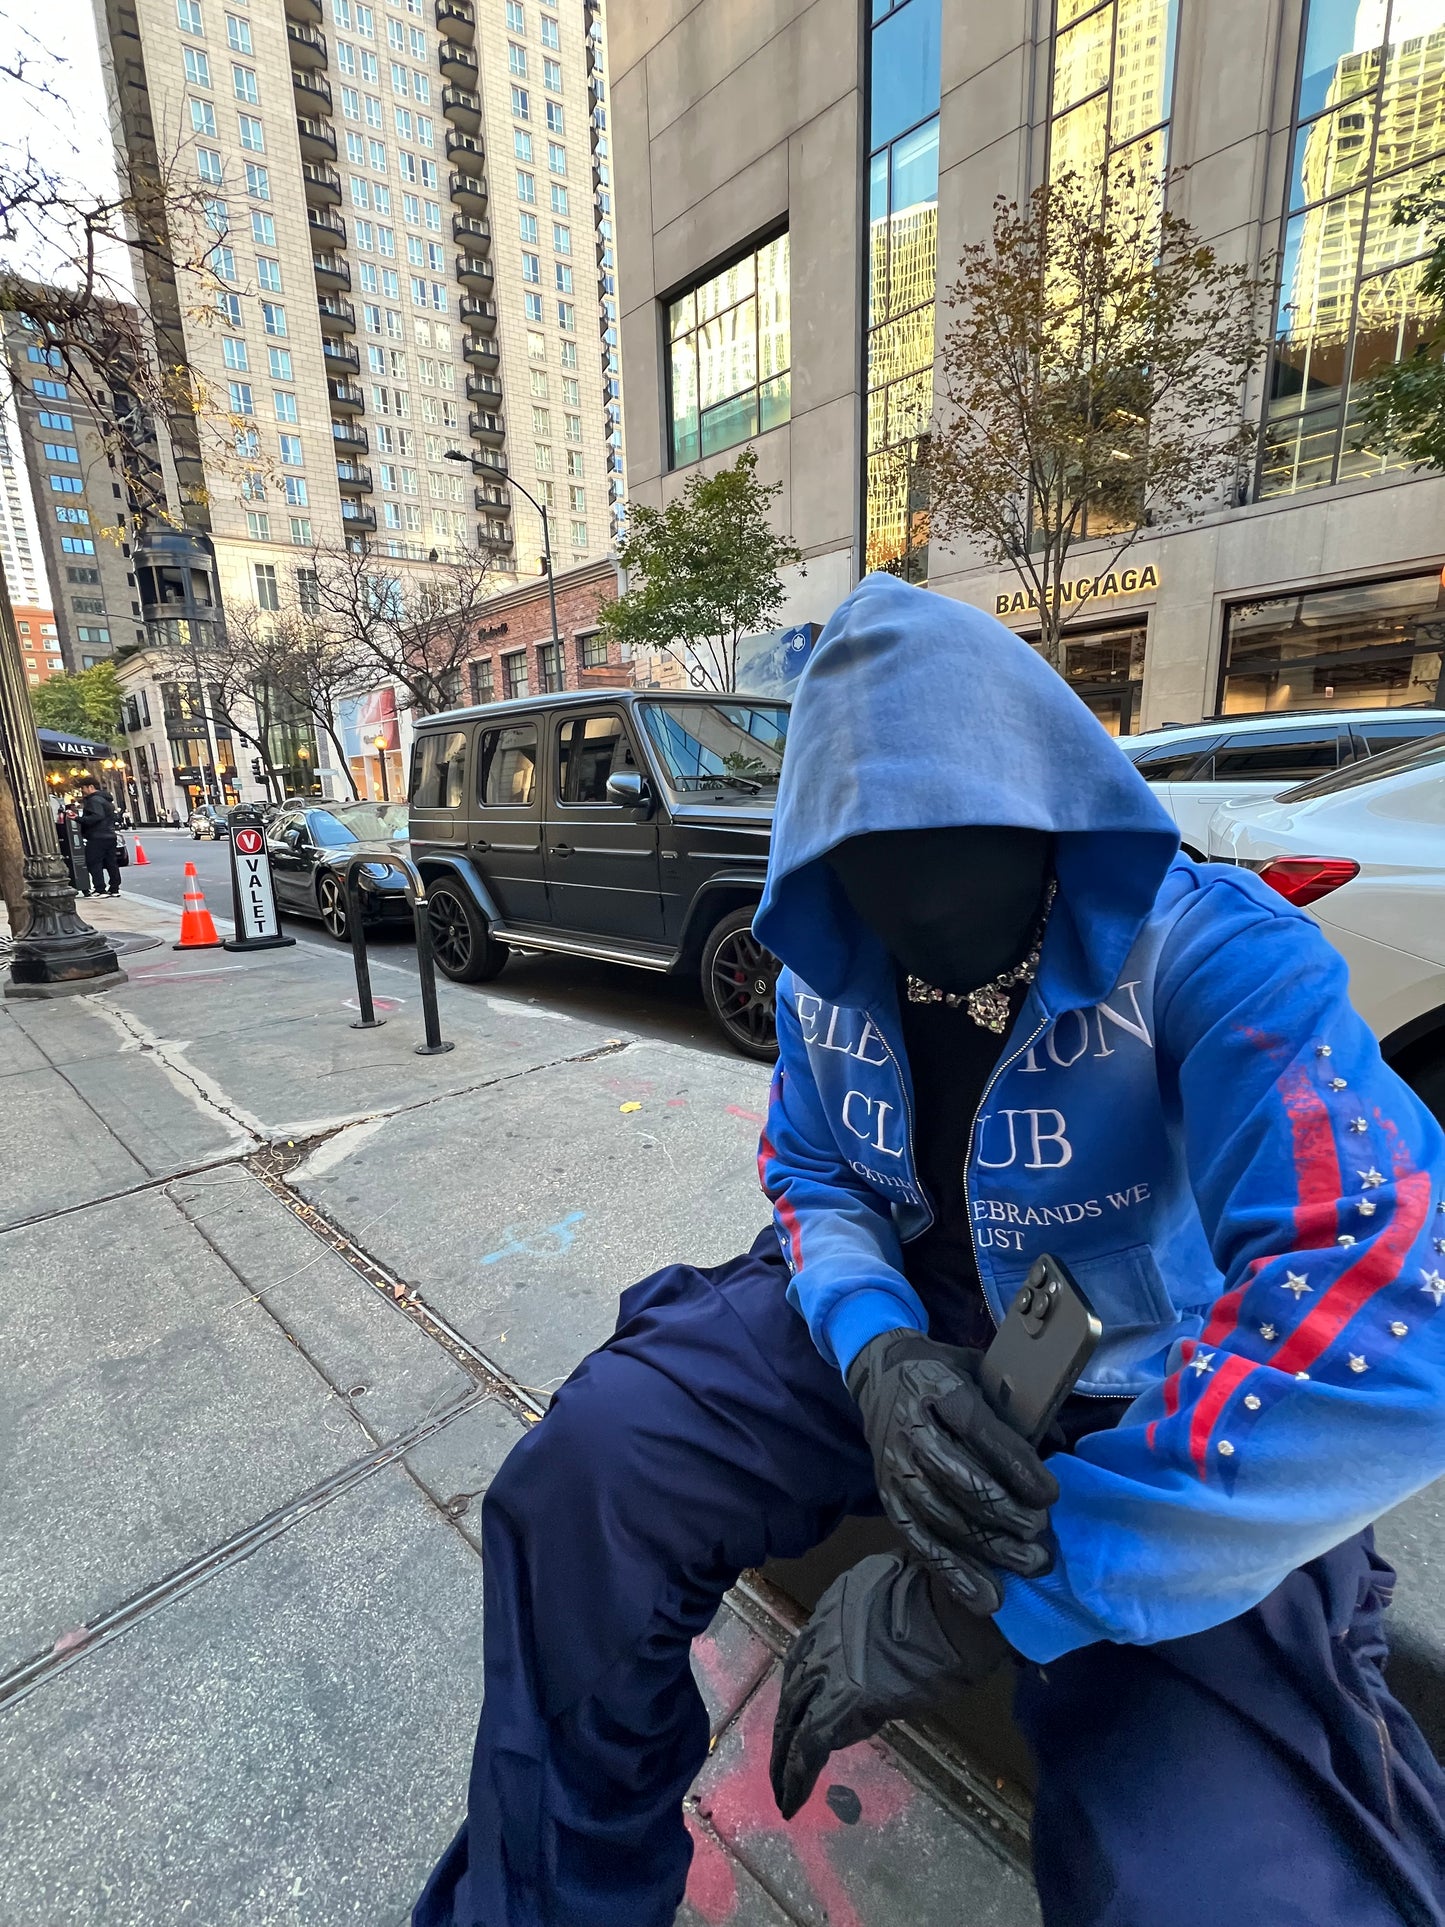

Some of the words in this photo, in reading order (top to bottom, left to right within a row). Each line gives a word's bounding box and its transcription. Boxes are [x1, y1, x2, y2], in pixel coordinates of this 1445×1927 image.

[996, 566, 1157, 614] BALENCIAGA
[58, 741, 94, 755] VALET
[242, 833, 255, 850] V
[246, 859, 266, 933] VALET
[842, 1090, 904, 1158] CL
[977, 1109, 1072, 1168] UB
[972, 1200, 1103, 1226] EBRANDS
[1105, 1183, 1151, 1210] WE
[977, 1227, 1025, 1251] UST
